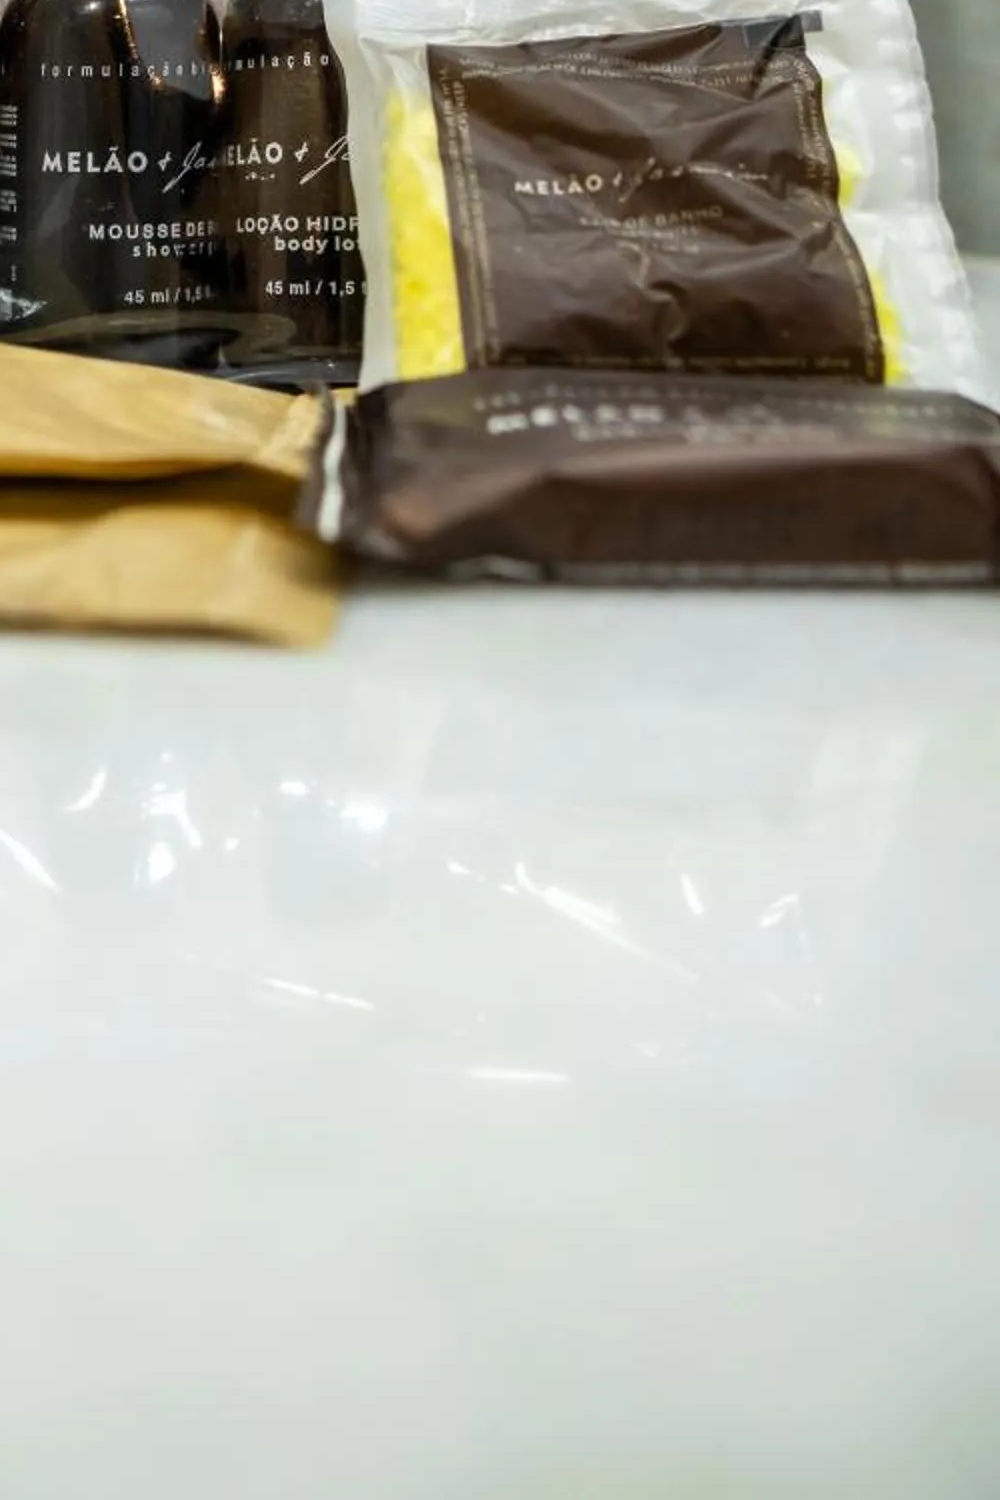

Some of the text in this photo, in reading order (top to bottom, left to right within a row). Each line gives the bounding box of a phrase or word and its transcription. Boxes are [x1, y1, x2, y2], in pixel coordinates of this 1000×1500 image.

[41, 146, 149, 174] MELÃO
[89, 222, 182, 240] MOUSSE
[236, 214, 299, 235] LOÇÃO
[274, 235, 356, 255] body lo
[123, 289, 145, 304] 45
[150, 288, 170, 303] ml
[265, 280, 283, 295] 45
[289, 280, 310, 295] ml
[328, 281, 355, 297] 1,5
